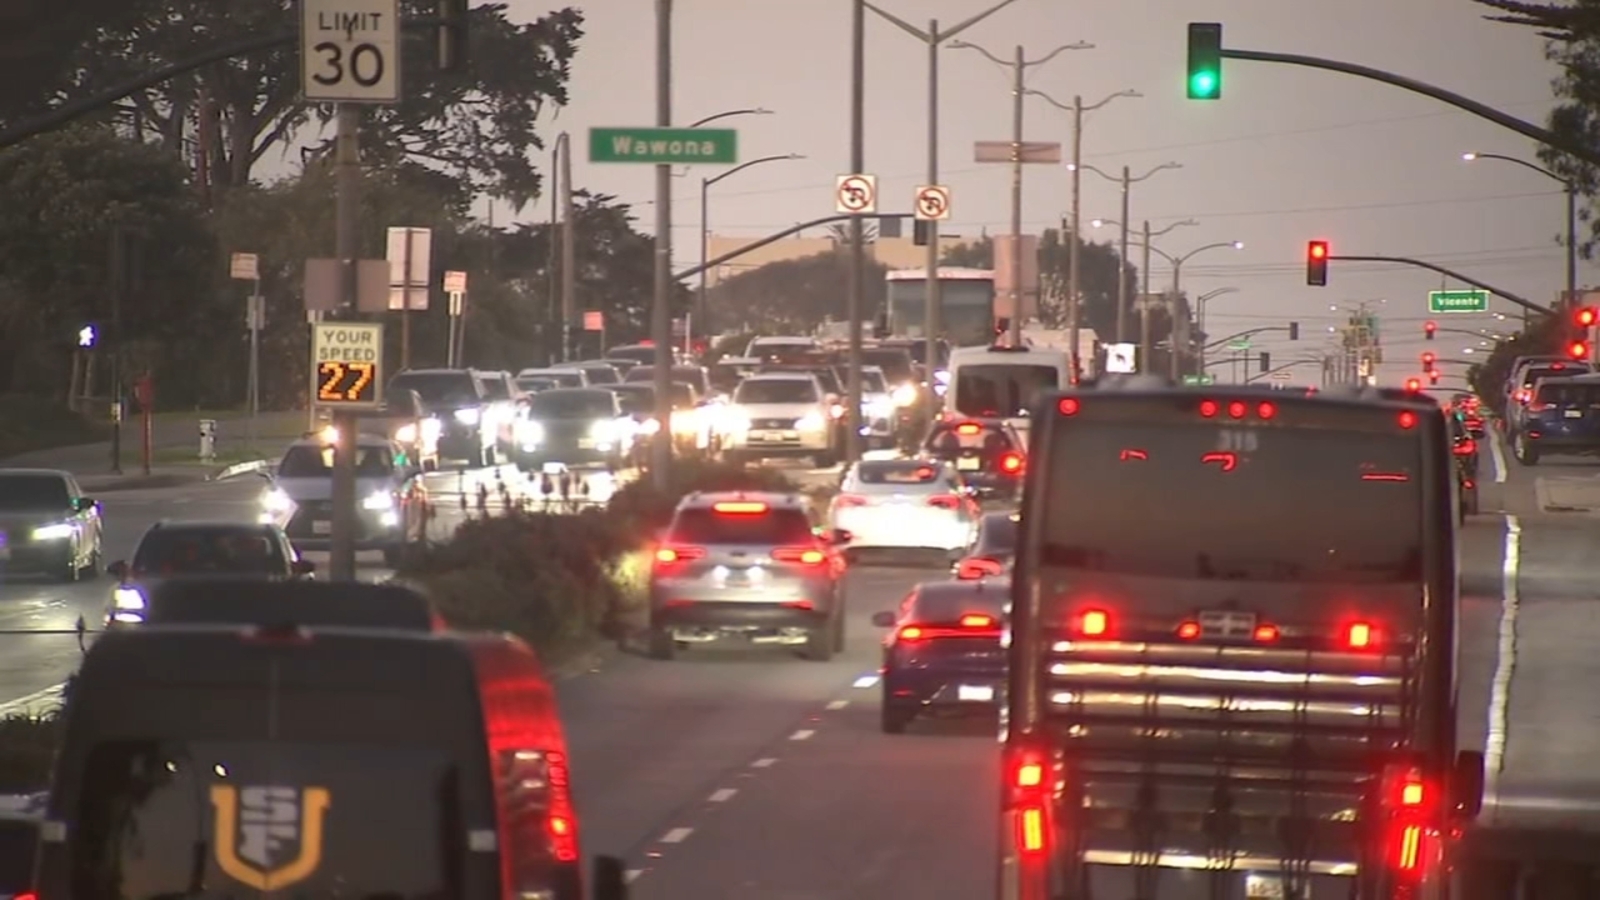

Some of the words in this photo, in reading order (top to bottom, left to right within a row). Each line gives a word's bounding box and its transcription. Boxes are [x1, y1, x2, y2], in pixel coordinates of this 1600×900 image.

[318, 12, 382, 31] LIMIT
[312, 41, 384, 88] 30
[612, 135, 716, 156] Wawona
[1437, 296, 1480, 306] Vicente
[323, 330, 372, 344] YOUR
[319, 347, 376, 361] SPEED
[319, 362, 372, 400] 27
